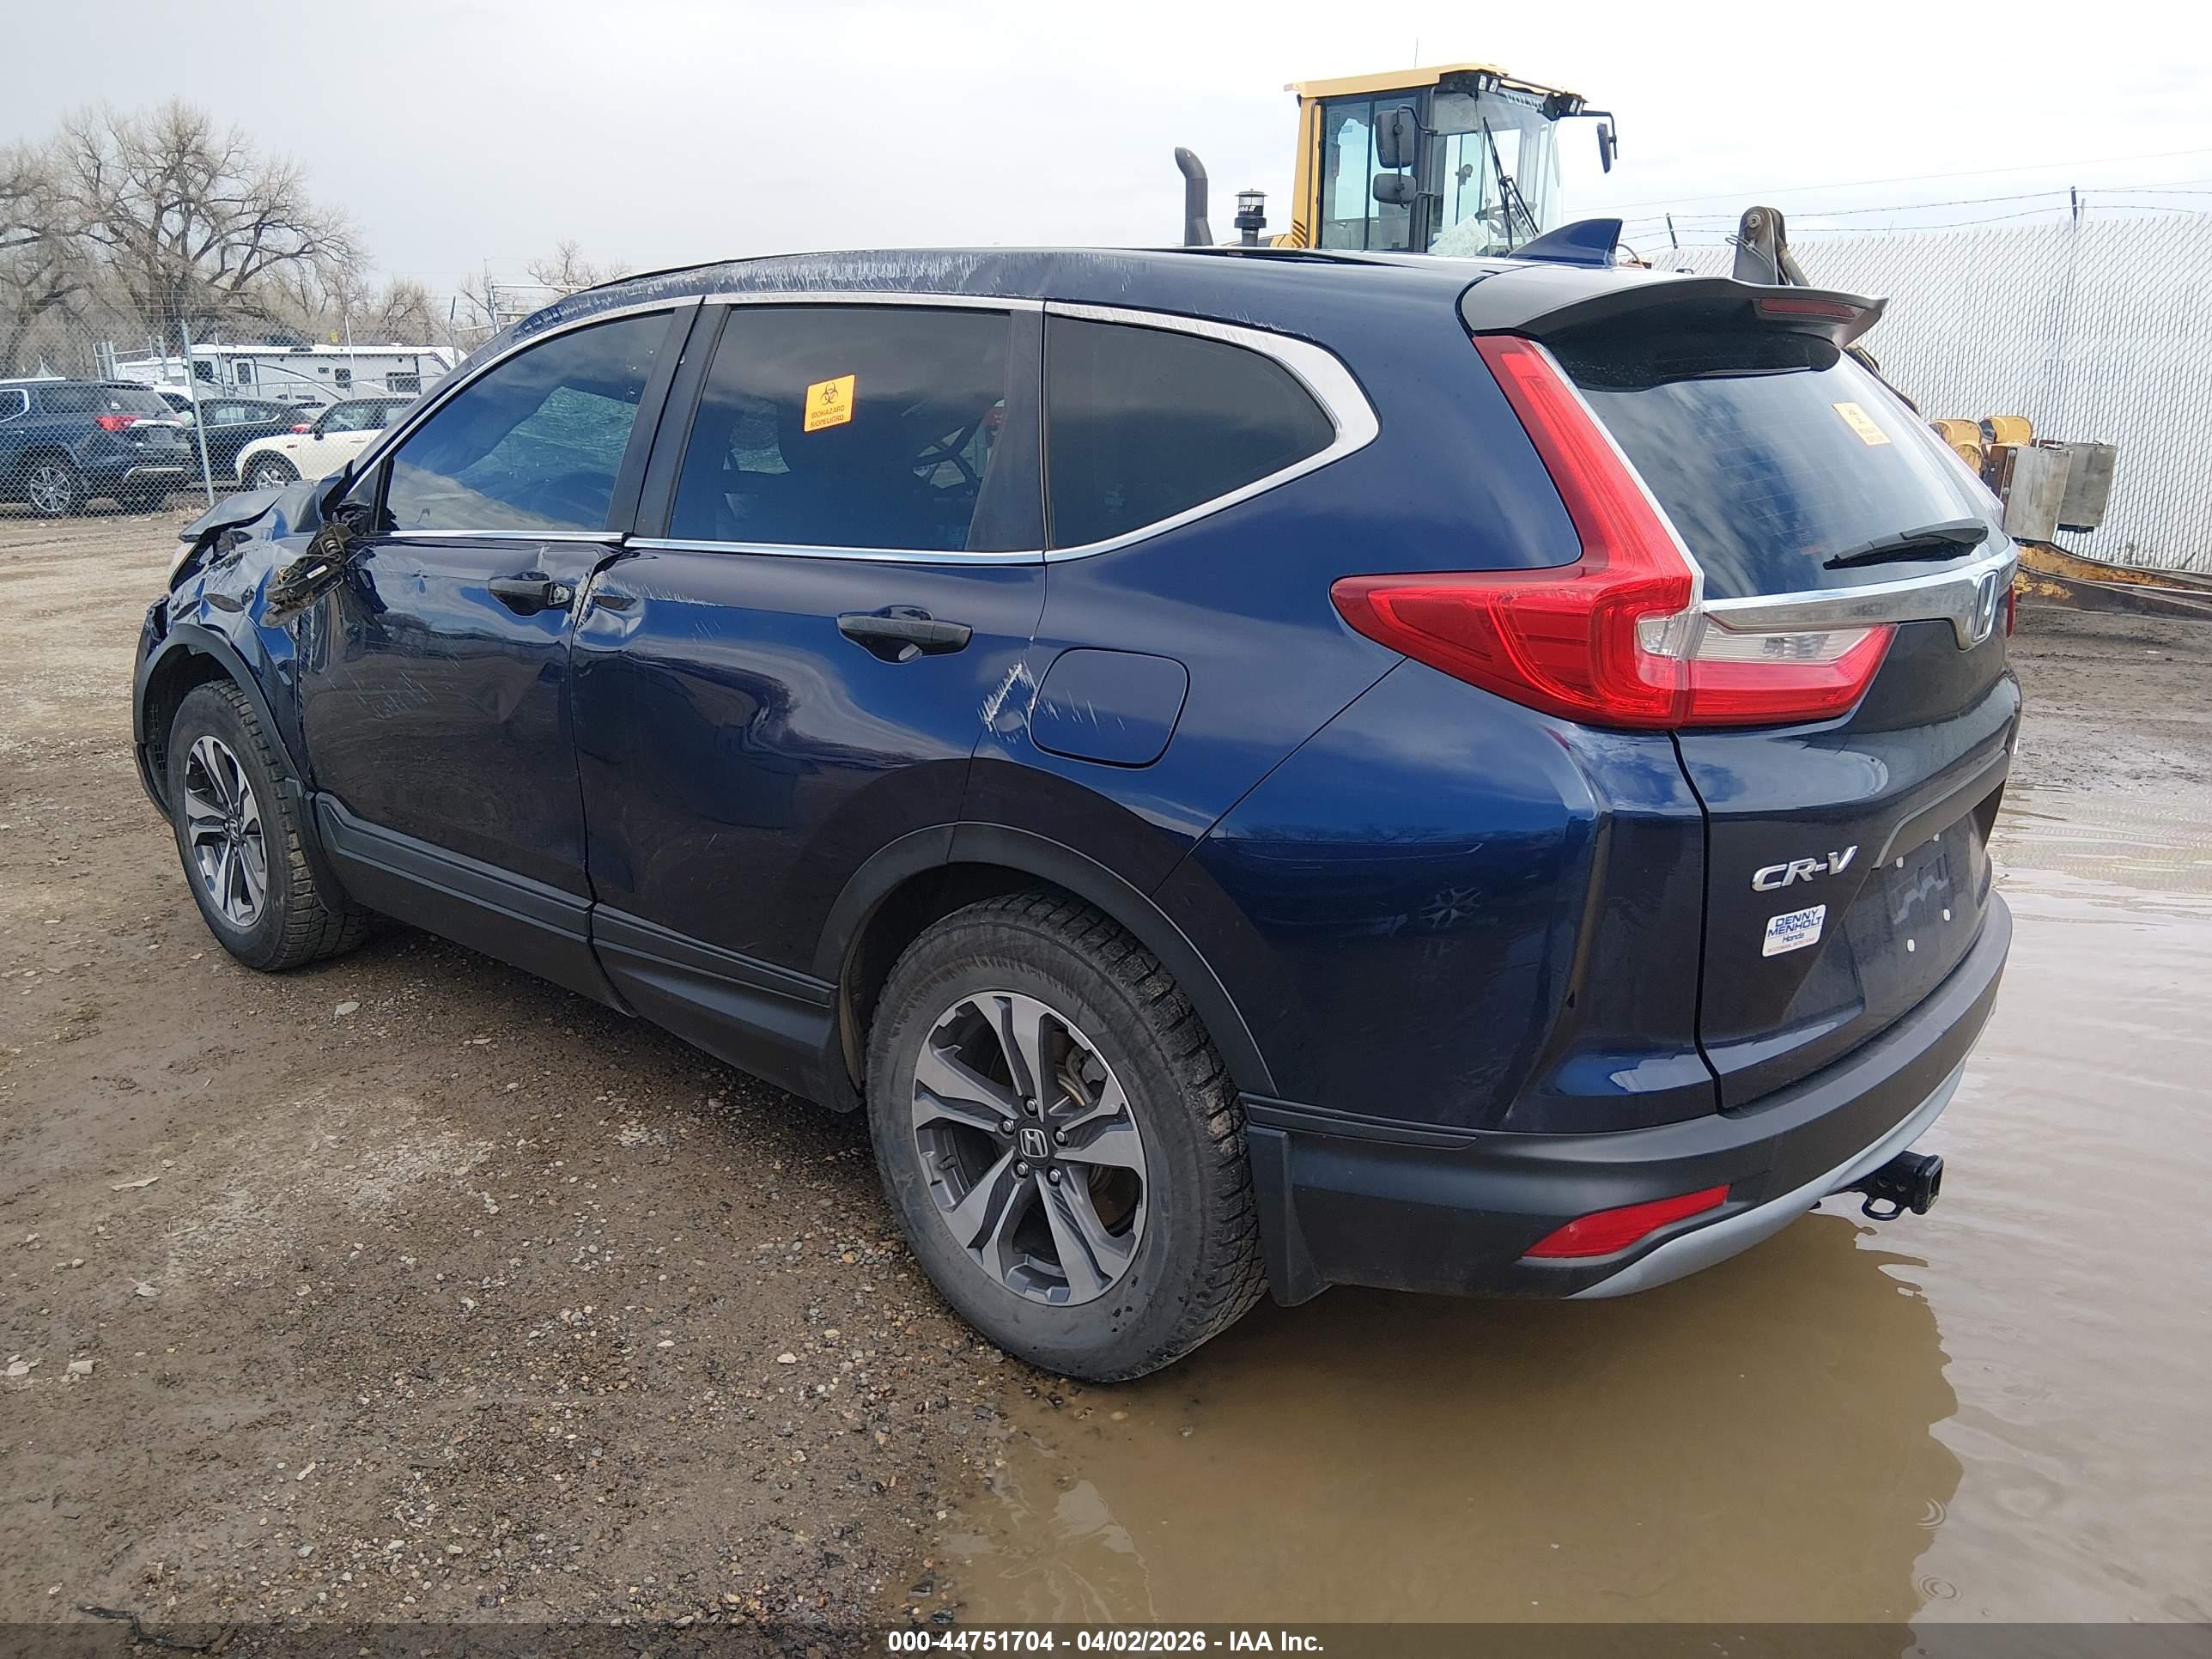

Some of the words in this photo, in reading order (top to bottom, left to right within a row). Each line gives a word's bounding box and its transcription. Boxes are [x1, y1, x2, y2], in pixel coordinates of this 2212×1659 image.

[1504, 92, 1544, 112] VOLVO
[1751, 845, 1858, 892] CR-V
[1767, 916, 1822, 938] MENHOLT
[1775, 908, 1819, 927] DENNY
[1782, 933, 1805, 943] Honda
